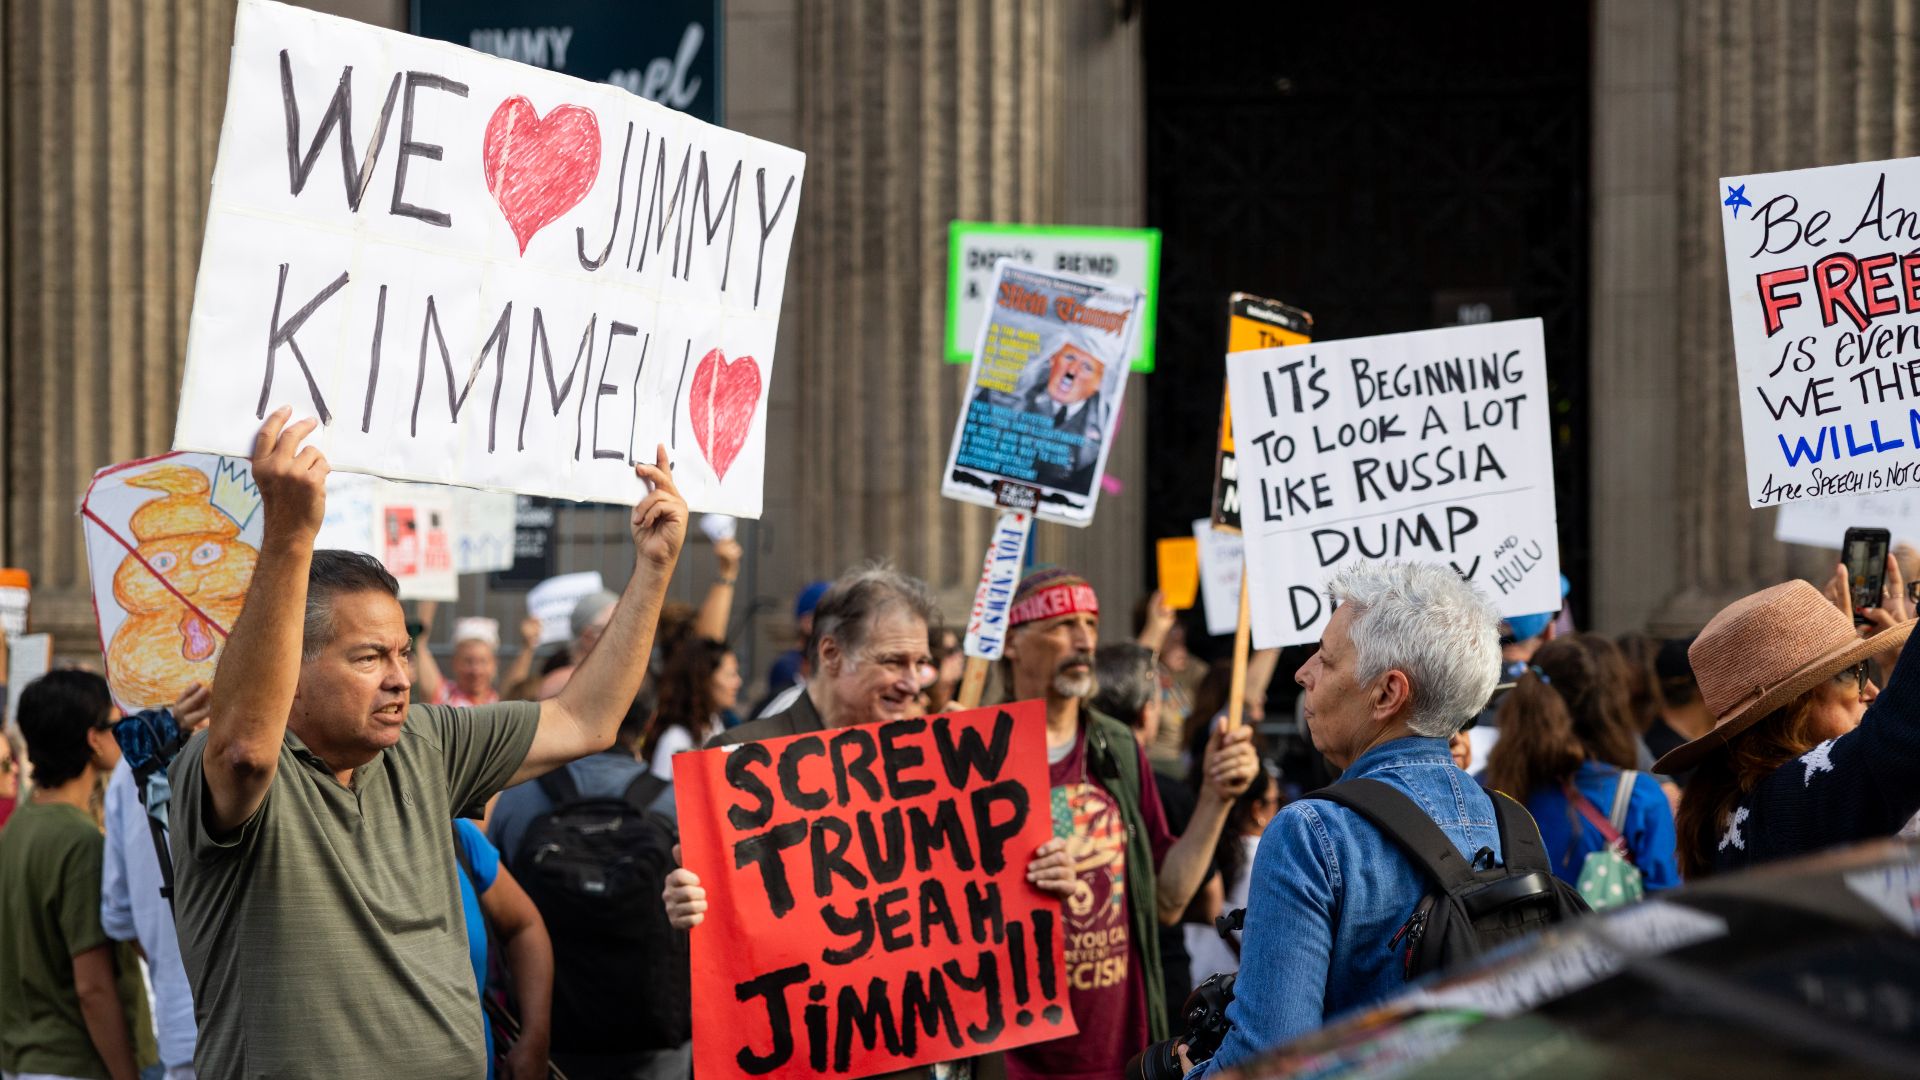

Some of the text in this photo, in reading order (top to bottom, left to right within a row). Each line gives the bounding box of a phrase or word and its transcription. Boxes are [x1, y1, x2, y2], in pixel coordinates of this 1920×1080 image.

[279, 48, 796, 309] WE JIMMY
[1750, 194, 1831, 258] Be
[1056, 252, 1118, 276] BEND
[1351, 350, 1524, 409] BEGINNING
[1757, 377, 1841, 421] WE
[1251, 394, 1527, 466] TO LOOK A LOT
[1778, 419, 1904, 467] WILL
[1260, 473, 1333, 522] LIKE
[1353, 443, 1507, 503] RUSSIA
[1806, 467, 1863, 497] SPEECH
[1867, 469, 1882, 489] IS
[1886, 461, 1914, 487] NOT
[998, 529, 1023, 563] FOX
[1311, 506, 1478, 567] DUMP
[1493, 535, 1518, 559] AND
[1490, 539, 1543, 595] HULU
[978, 636, 1000, 655] IS
[724, 710, 1014, 831] SCREW
[732, 778, 1031, 919] TRUMP
[820, 877, 1005, 966] YEAH
[1070, 924, 1128, 949] YOU CA
